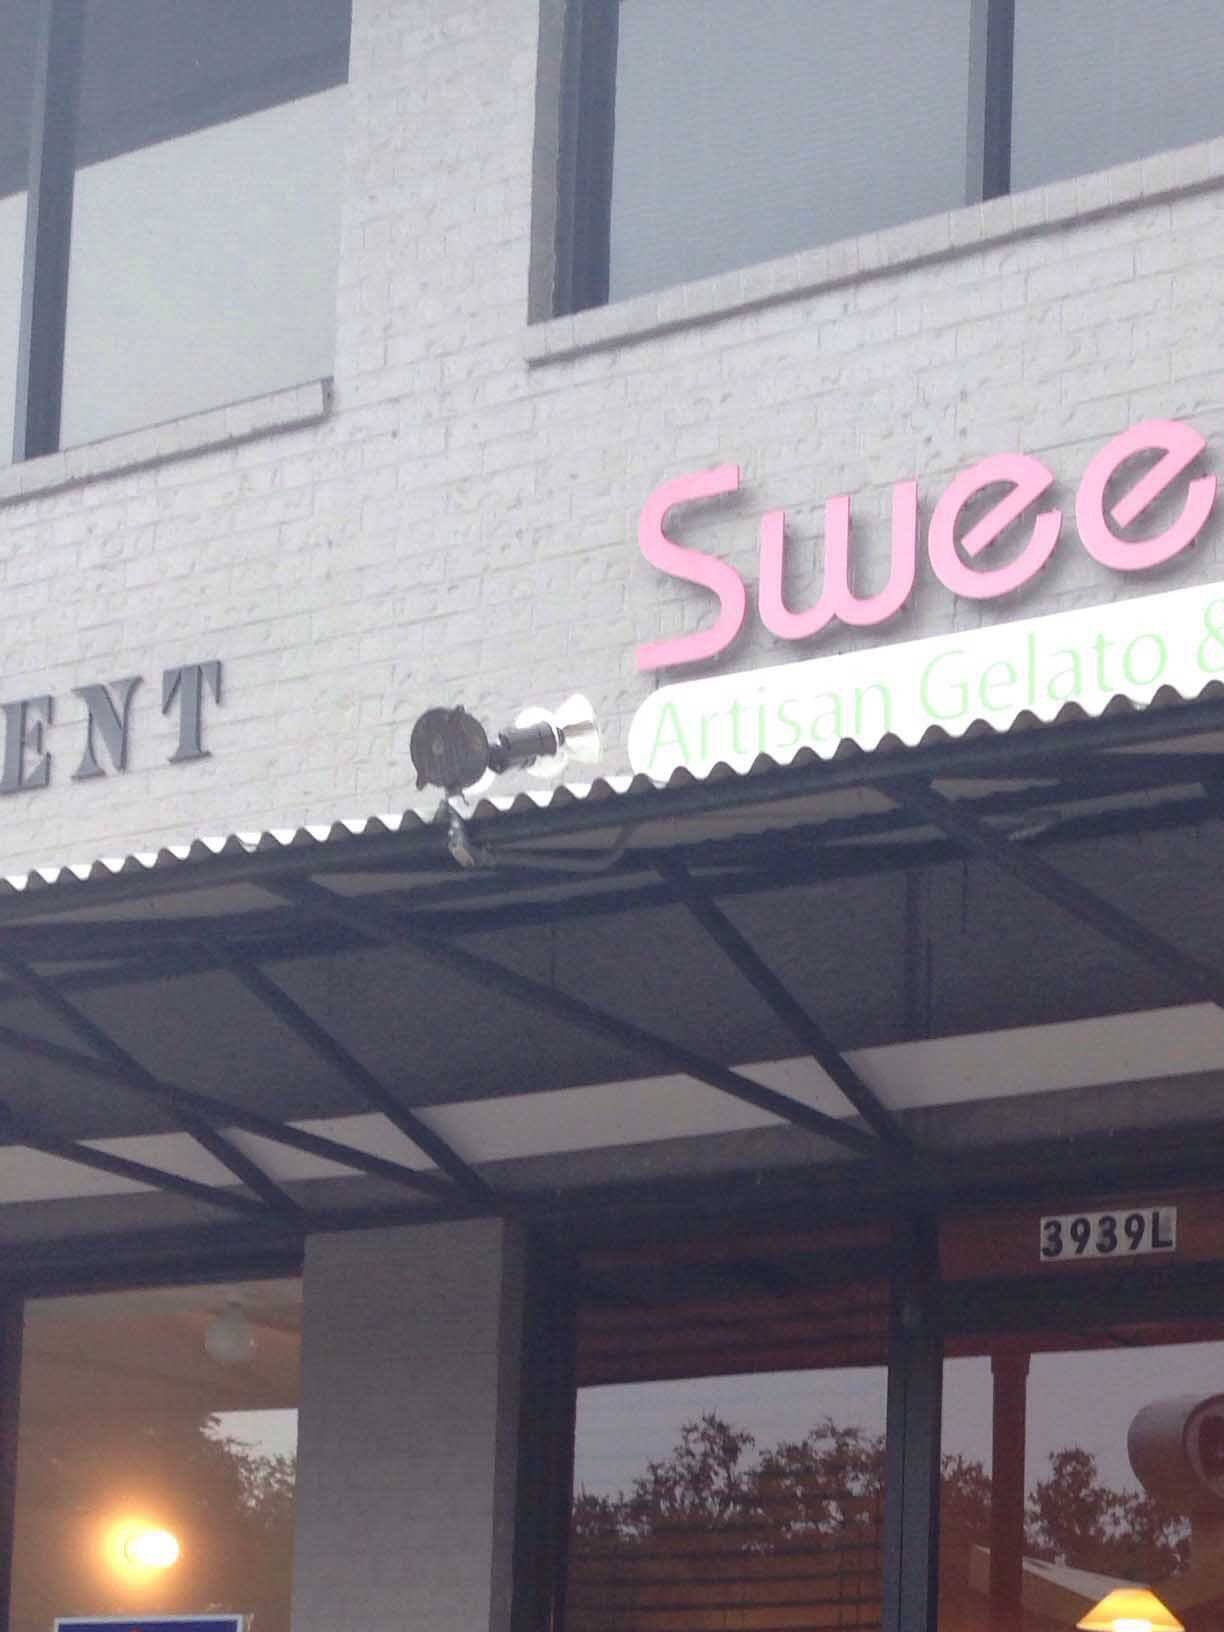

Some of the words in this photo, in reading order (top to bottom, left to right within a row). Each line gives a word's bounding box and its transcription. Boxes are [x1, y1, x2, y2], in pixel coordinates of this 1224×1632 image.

[0, 660, 222, 795] ENT
[647, 675, 894, 767] Artisan
[920, 632, 1169, 720] Gelato
[1042, 1211, 1173, 1257] 3939L
